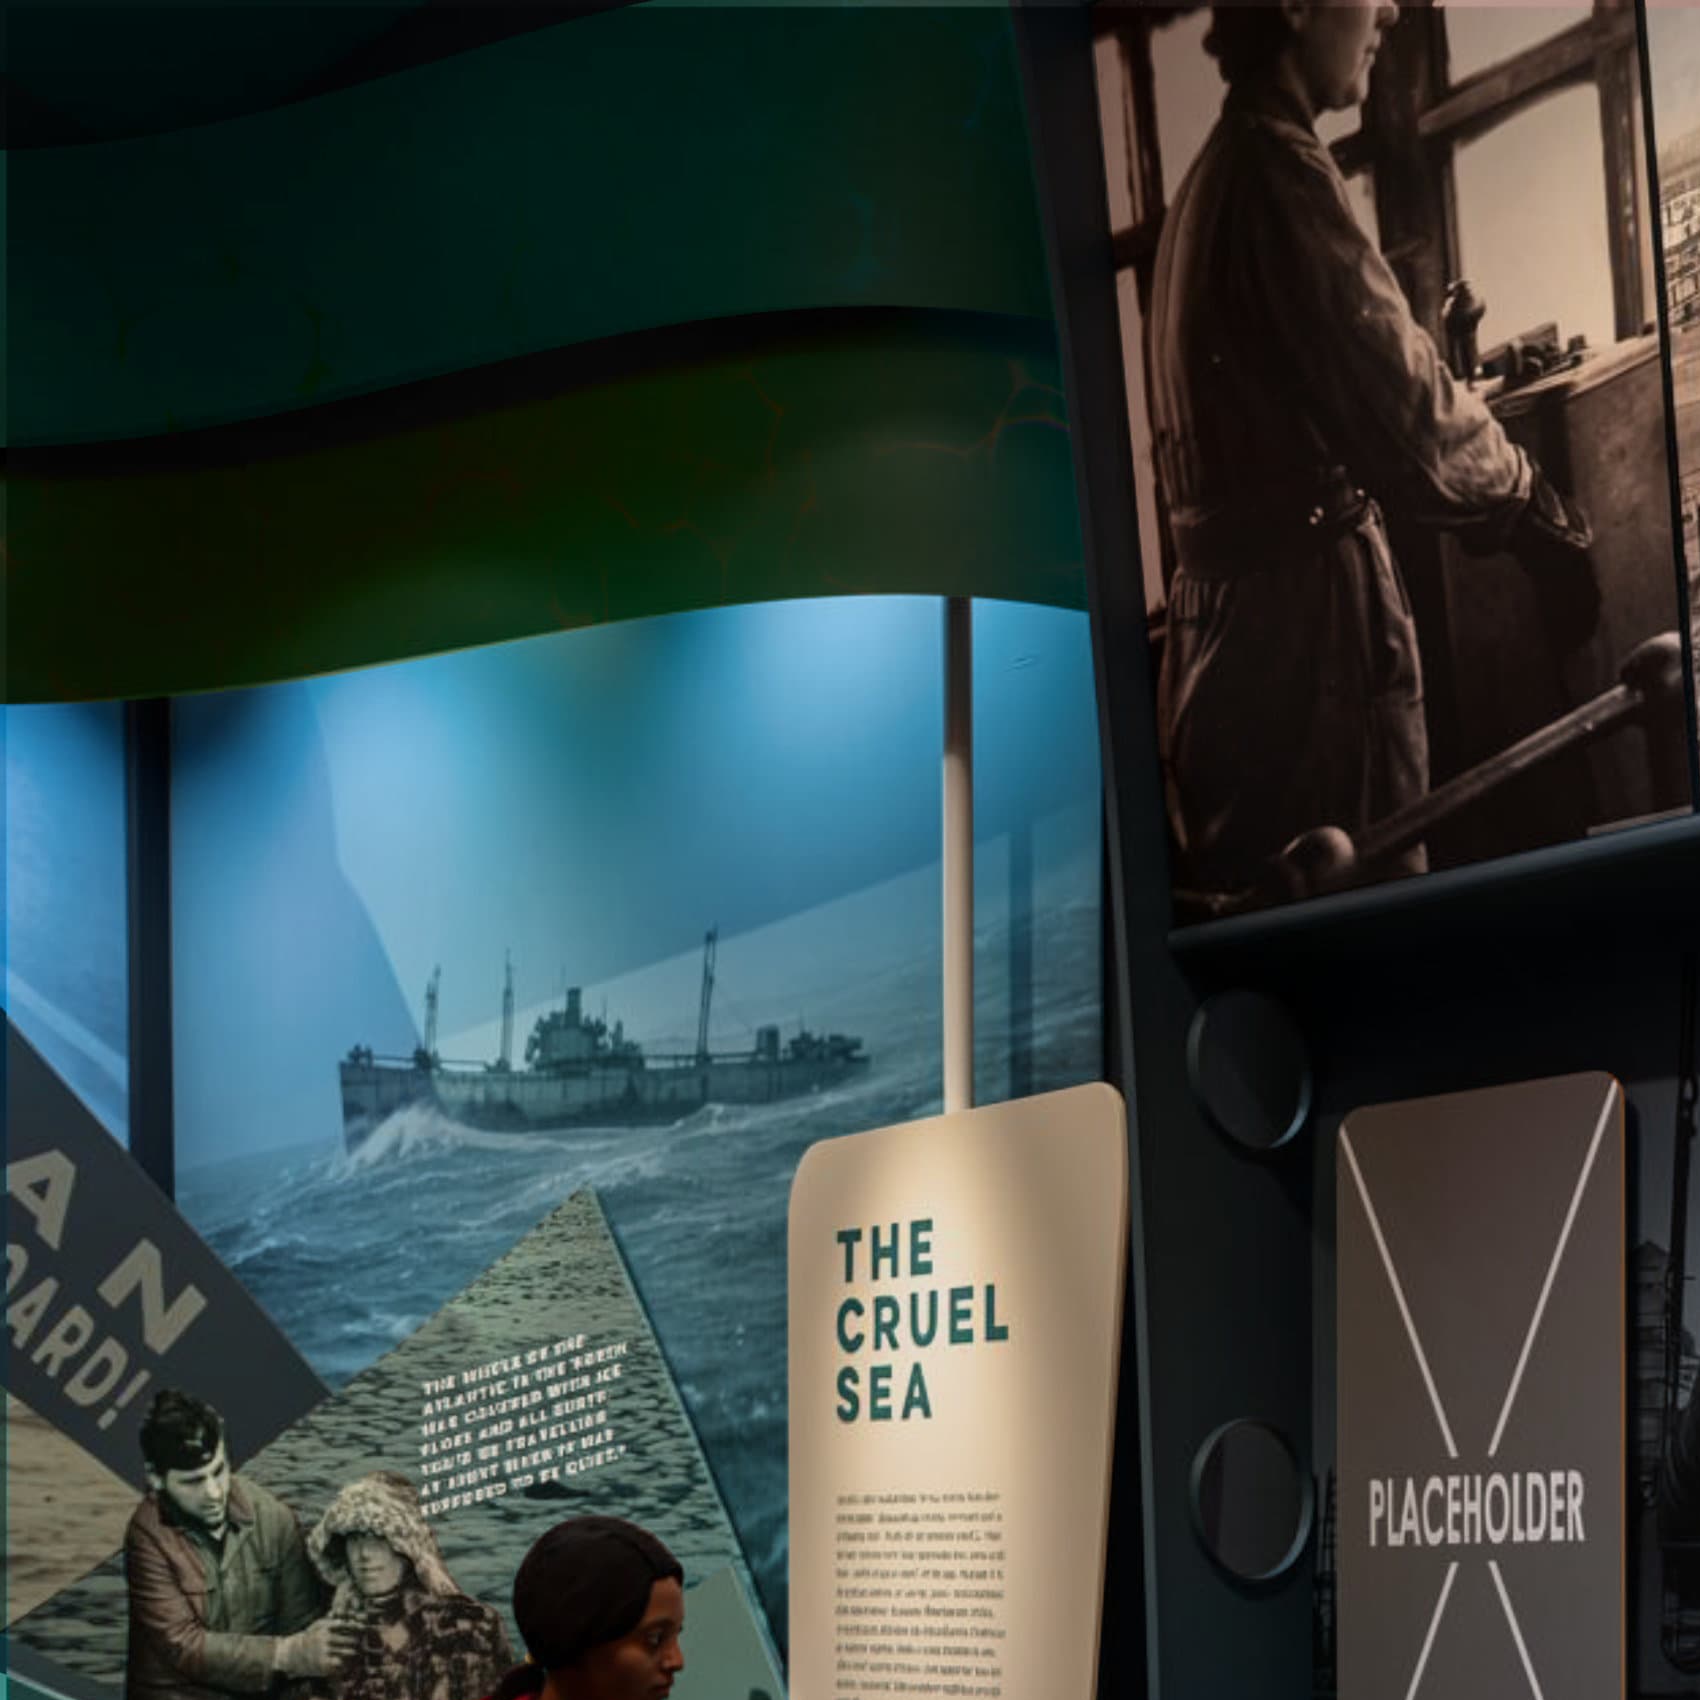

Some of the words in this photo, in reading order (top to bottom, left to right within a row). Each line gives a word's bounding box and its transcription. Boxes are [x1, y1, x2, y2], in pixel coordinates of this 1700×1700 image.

[837, 1218, 934, 1283] THE
[837, 1284, 1009, 1353] CRUEL
[837, 1363, 932, 1423] SEA
[1369, 1469, 1584, 1546] PLACEHOLDER
